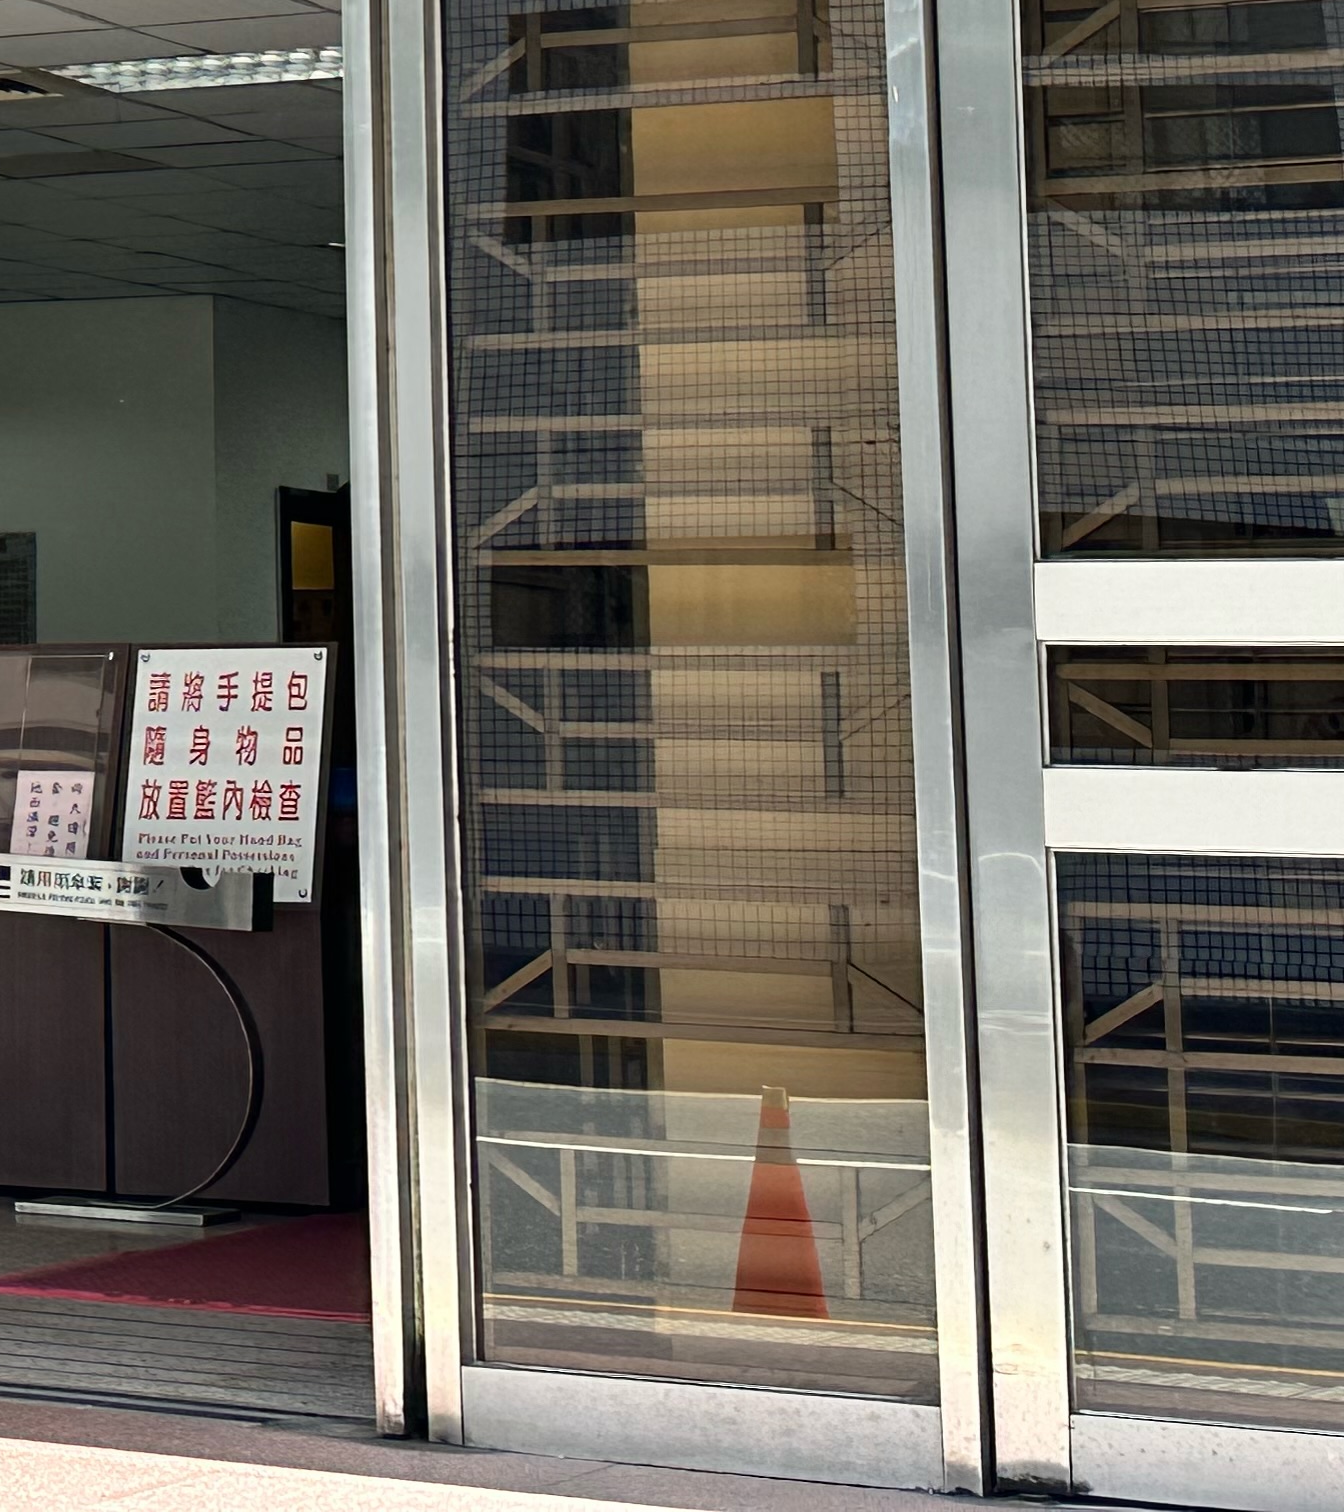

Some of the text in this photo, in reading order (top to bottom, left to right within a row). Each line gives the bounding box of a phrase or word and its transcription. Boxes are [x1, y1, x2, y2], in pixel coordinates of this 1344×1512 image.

[147, 670, 309, 712] 請將手提包
[142, 724, 304, 766] 隨身物品
[137, 832, 177, 845] Please
